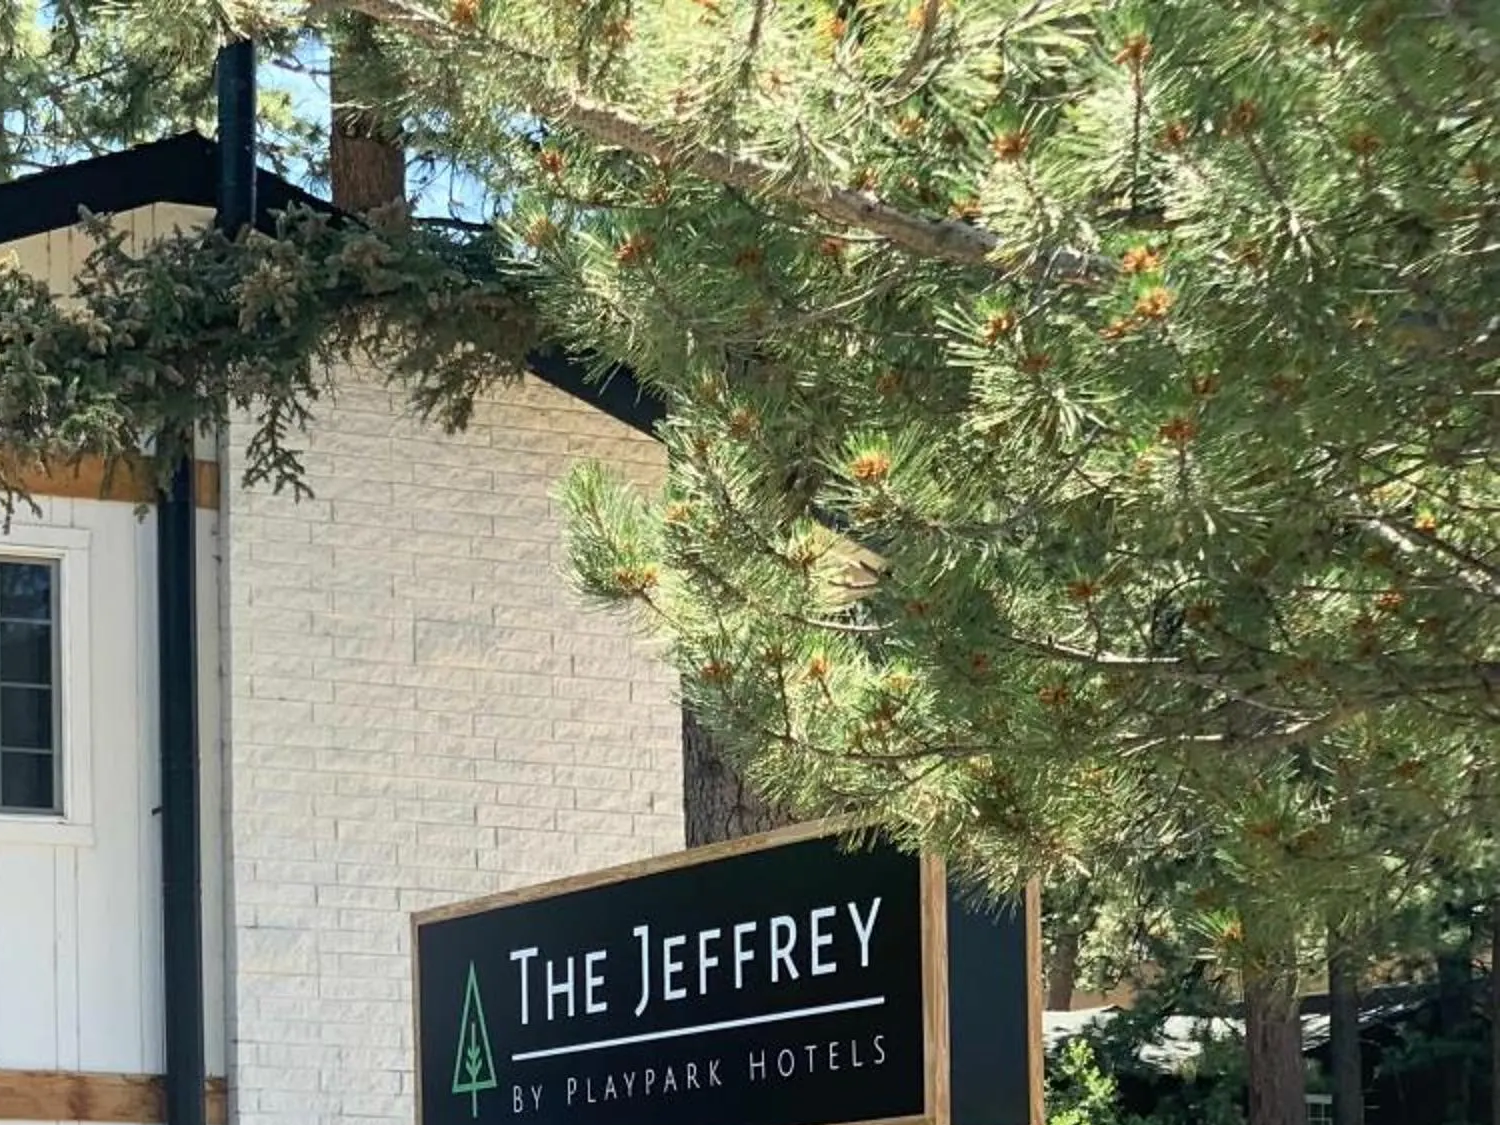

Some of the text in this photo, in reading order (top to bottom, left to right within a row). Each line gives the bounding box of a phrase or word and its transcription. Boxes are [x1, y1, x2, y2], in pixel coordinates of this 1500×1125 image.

[510, 897, 883, 1026] THE JEFFREY
[512, 1034, 887, 1114] BY PLAYPARK HOTELS
